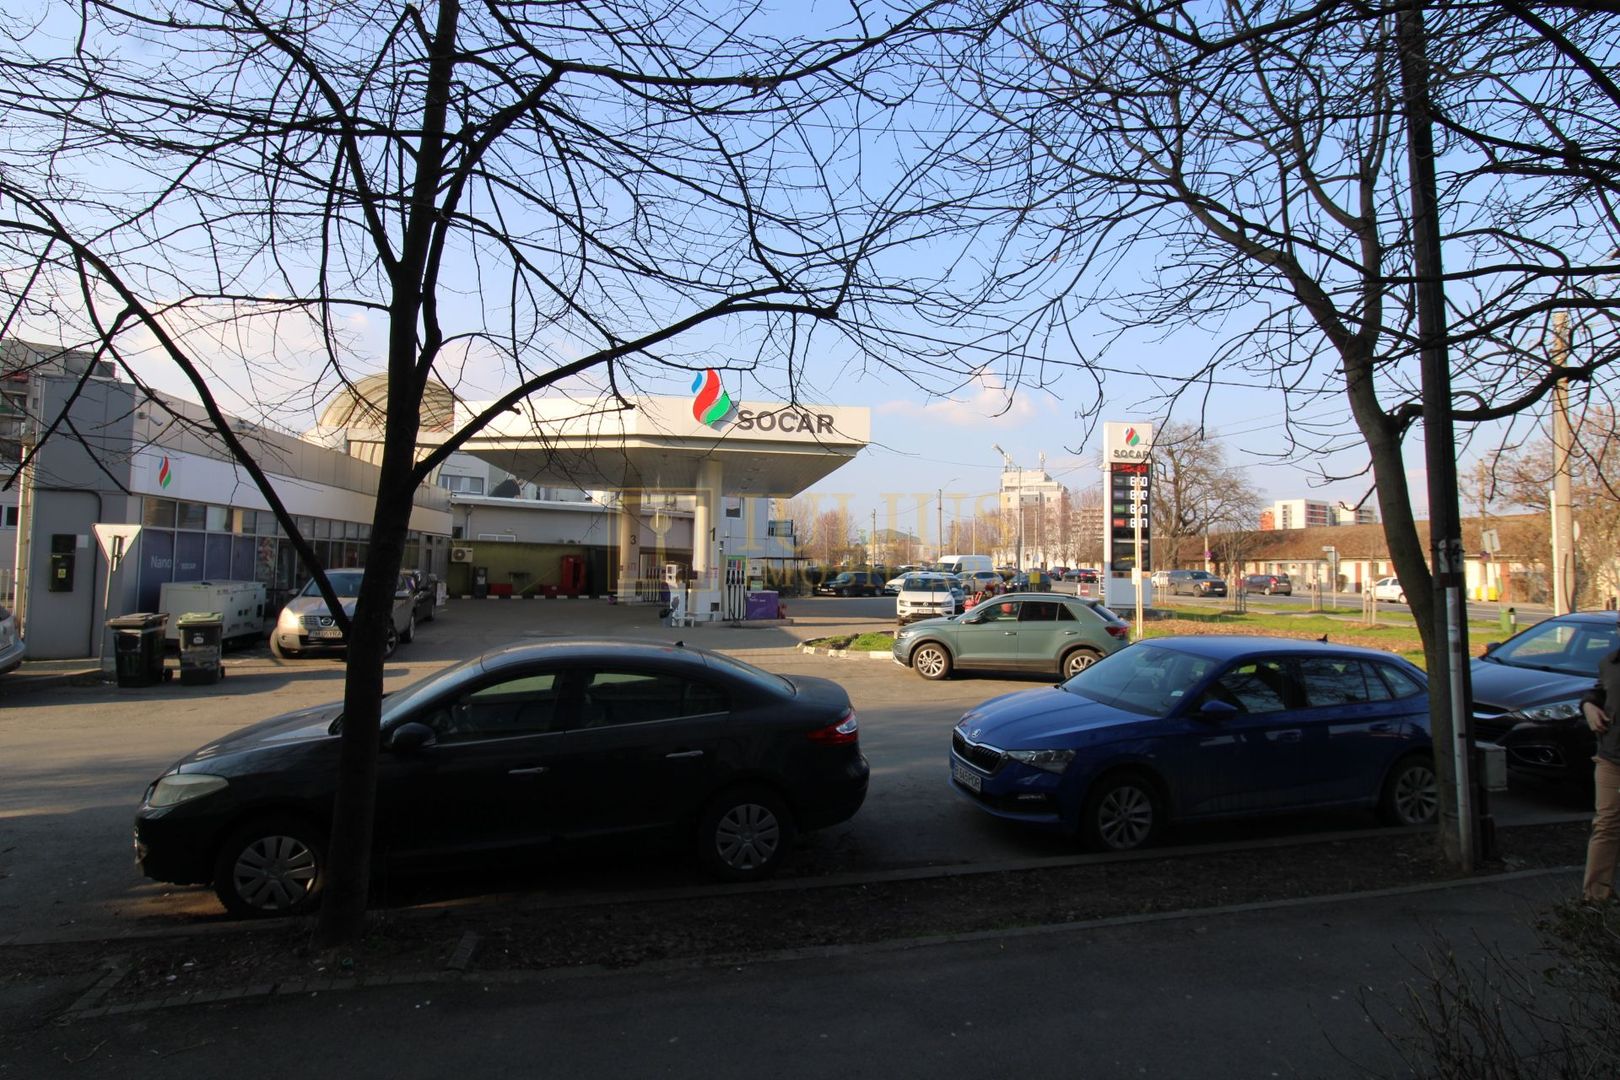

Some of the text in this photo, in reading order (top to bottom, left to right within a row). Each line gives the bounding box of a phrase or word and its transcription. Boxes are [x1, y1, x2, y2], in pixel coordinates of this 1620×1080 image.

[736, 410, 835, 435] SOCAR
[630, 535, 637, 545] 3
[710, 527, 716, 541] 1
